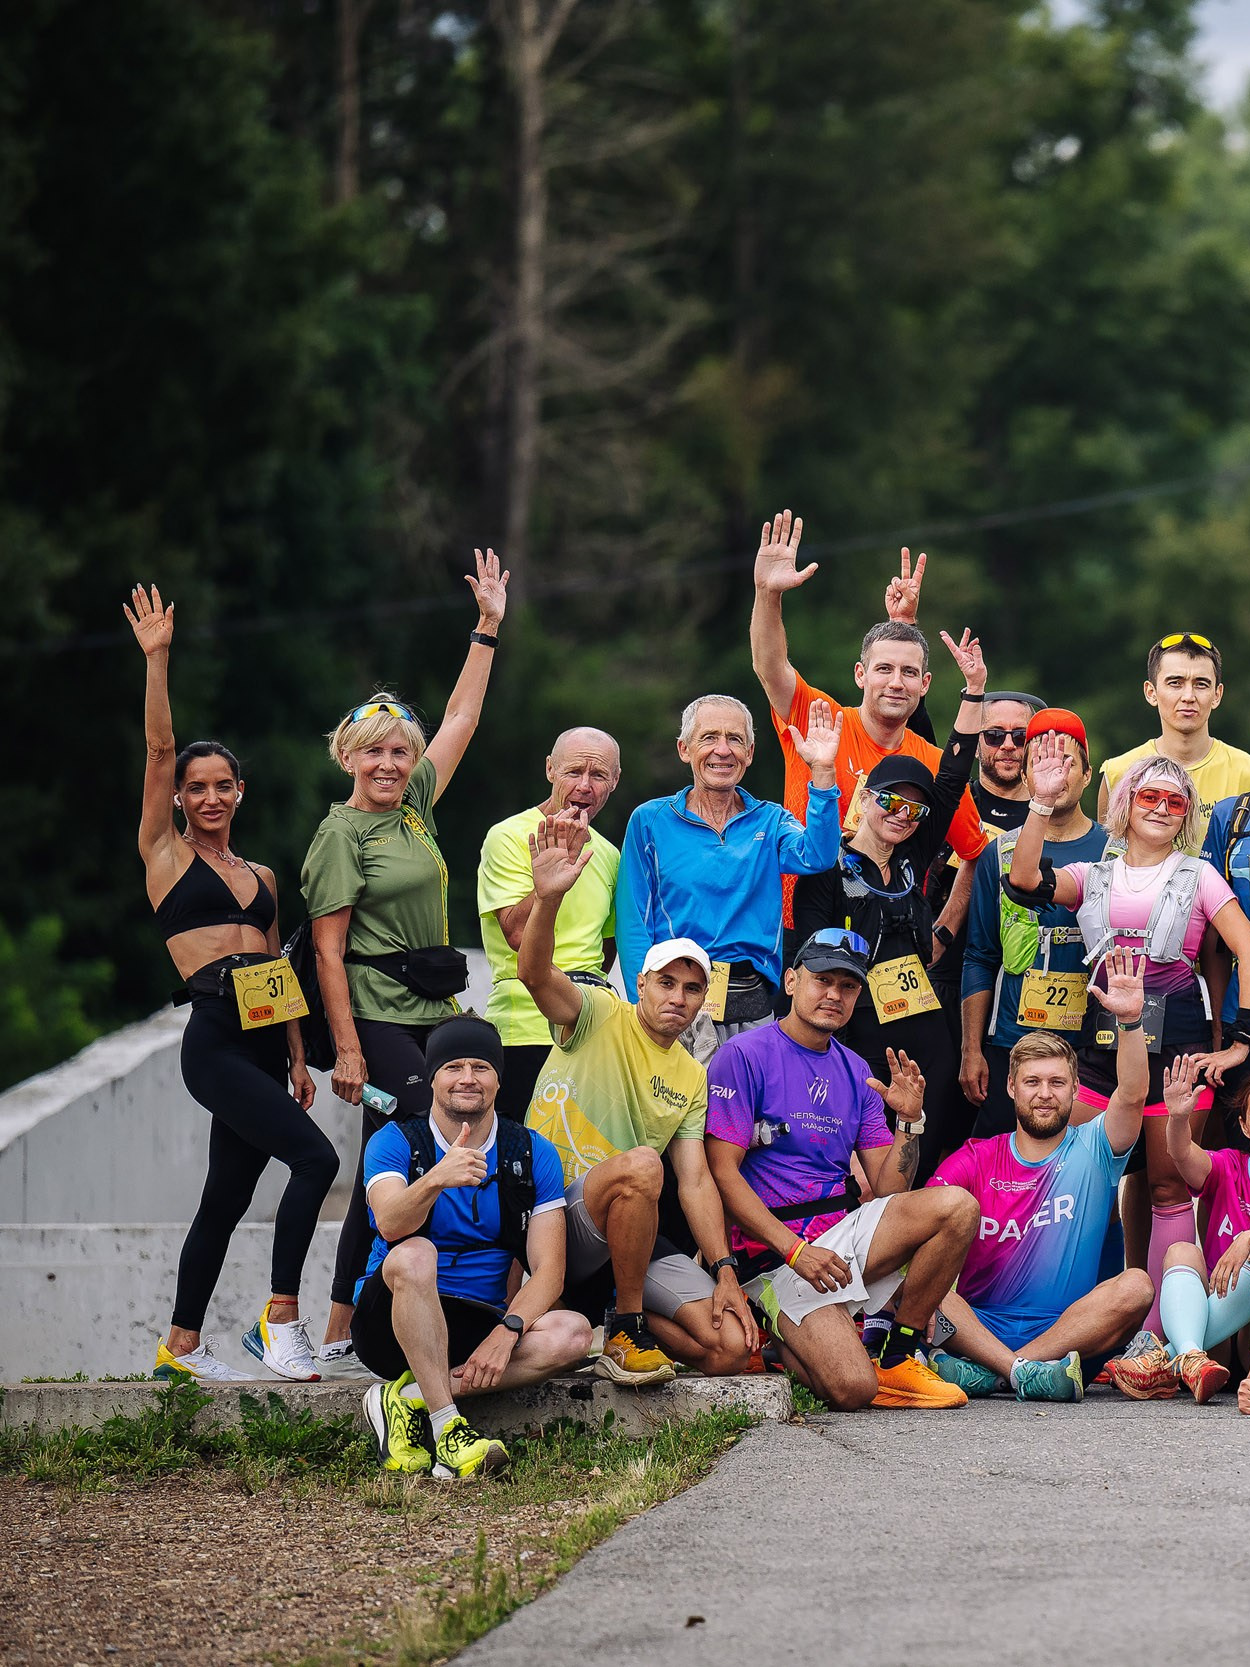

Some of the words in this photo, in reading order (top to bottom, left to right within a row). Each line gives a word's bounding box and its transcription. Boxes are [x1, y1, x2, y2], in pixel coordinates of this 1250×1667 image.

[267, 975, 284, 998] 37
[897, 969, 919, 992] 36
[1046, 986, 1069, 1007] 22
[252, 1011, 263, 1019] 33,1
[887, 1004, 898, 1012] 33,1
